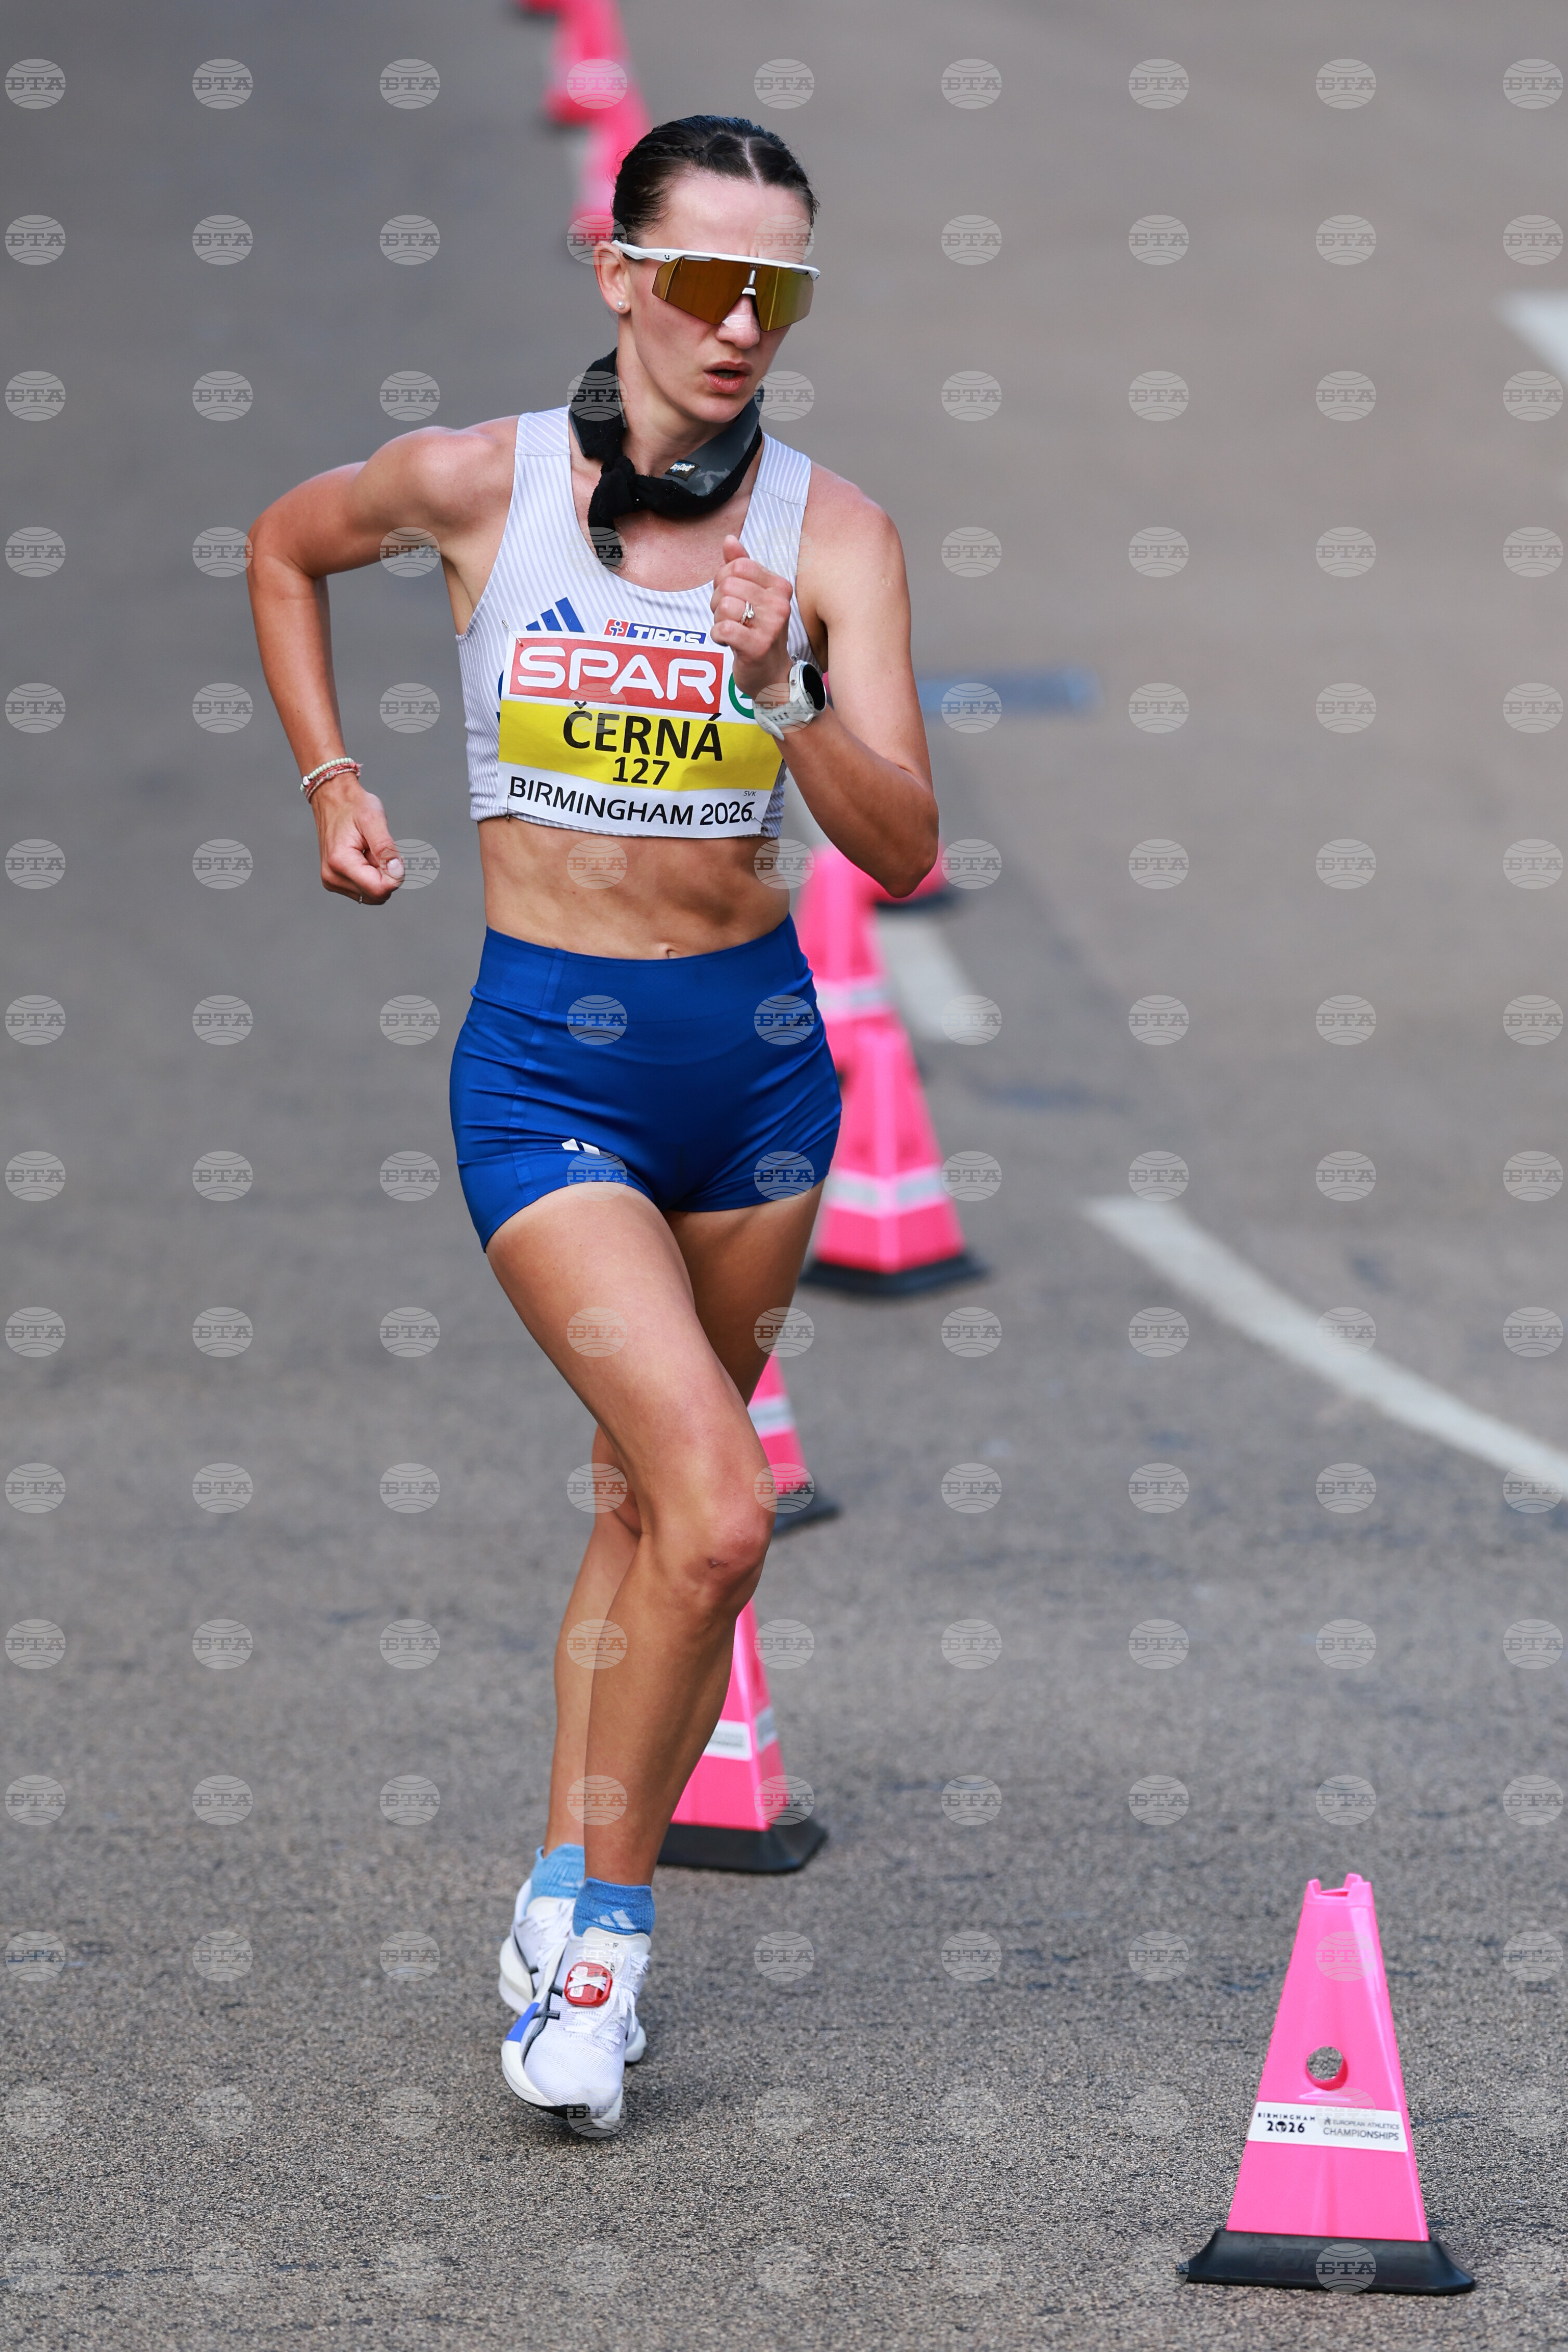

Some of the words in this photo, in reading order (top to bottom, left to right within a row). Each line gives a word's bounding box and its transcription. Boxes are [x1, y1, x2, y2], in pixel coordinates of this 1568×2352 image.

[633, 625, 702, 644] TIPOS
[517, 645, 717, 704] SPAR
[563, 701, 722, 761] ČERNÁ
[613, 757, 670, 785] 127
[510, 776, 694, 825] BIRMINGHAM
[699, 801, 755, 825] 2026
[1258, 2112, 1315, 2121] BIRMINGHAM
[1267, 2121, 1305, 2133] 2026
[1323, 2127, 1399, 2141] CHAMPIONSHIPS
